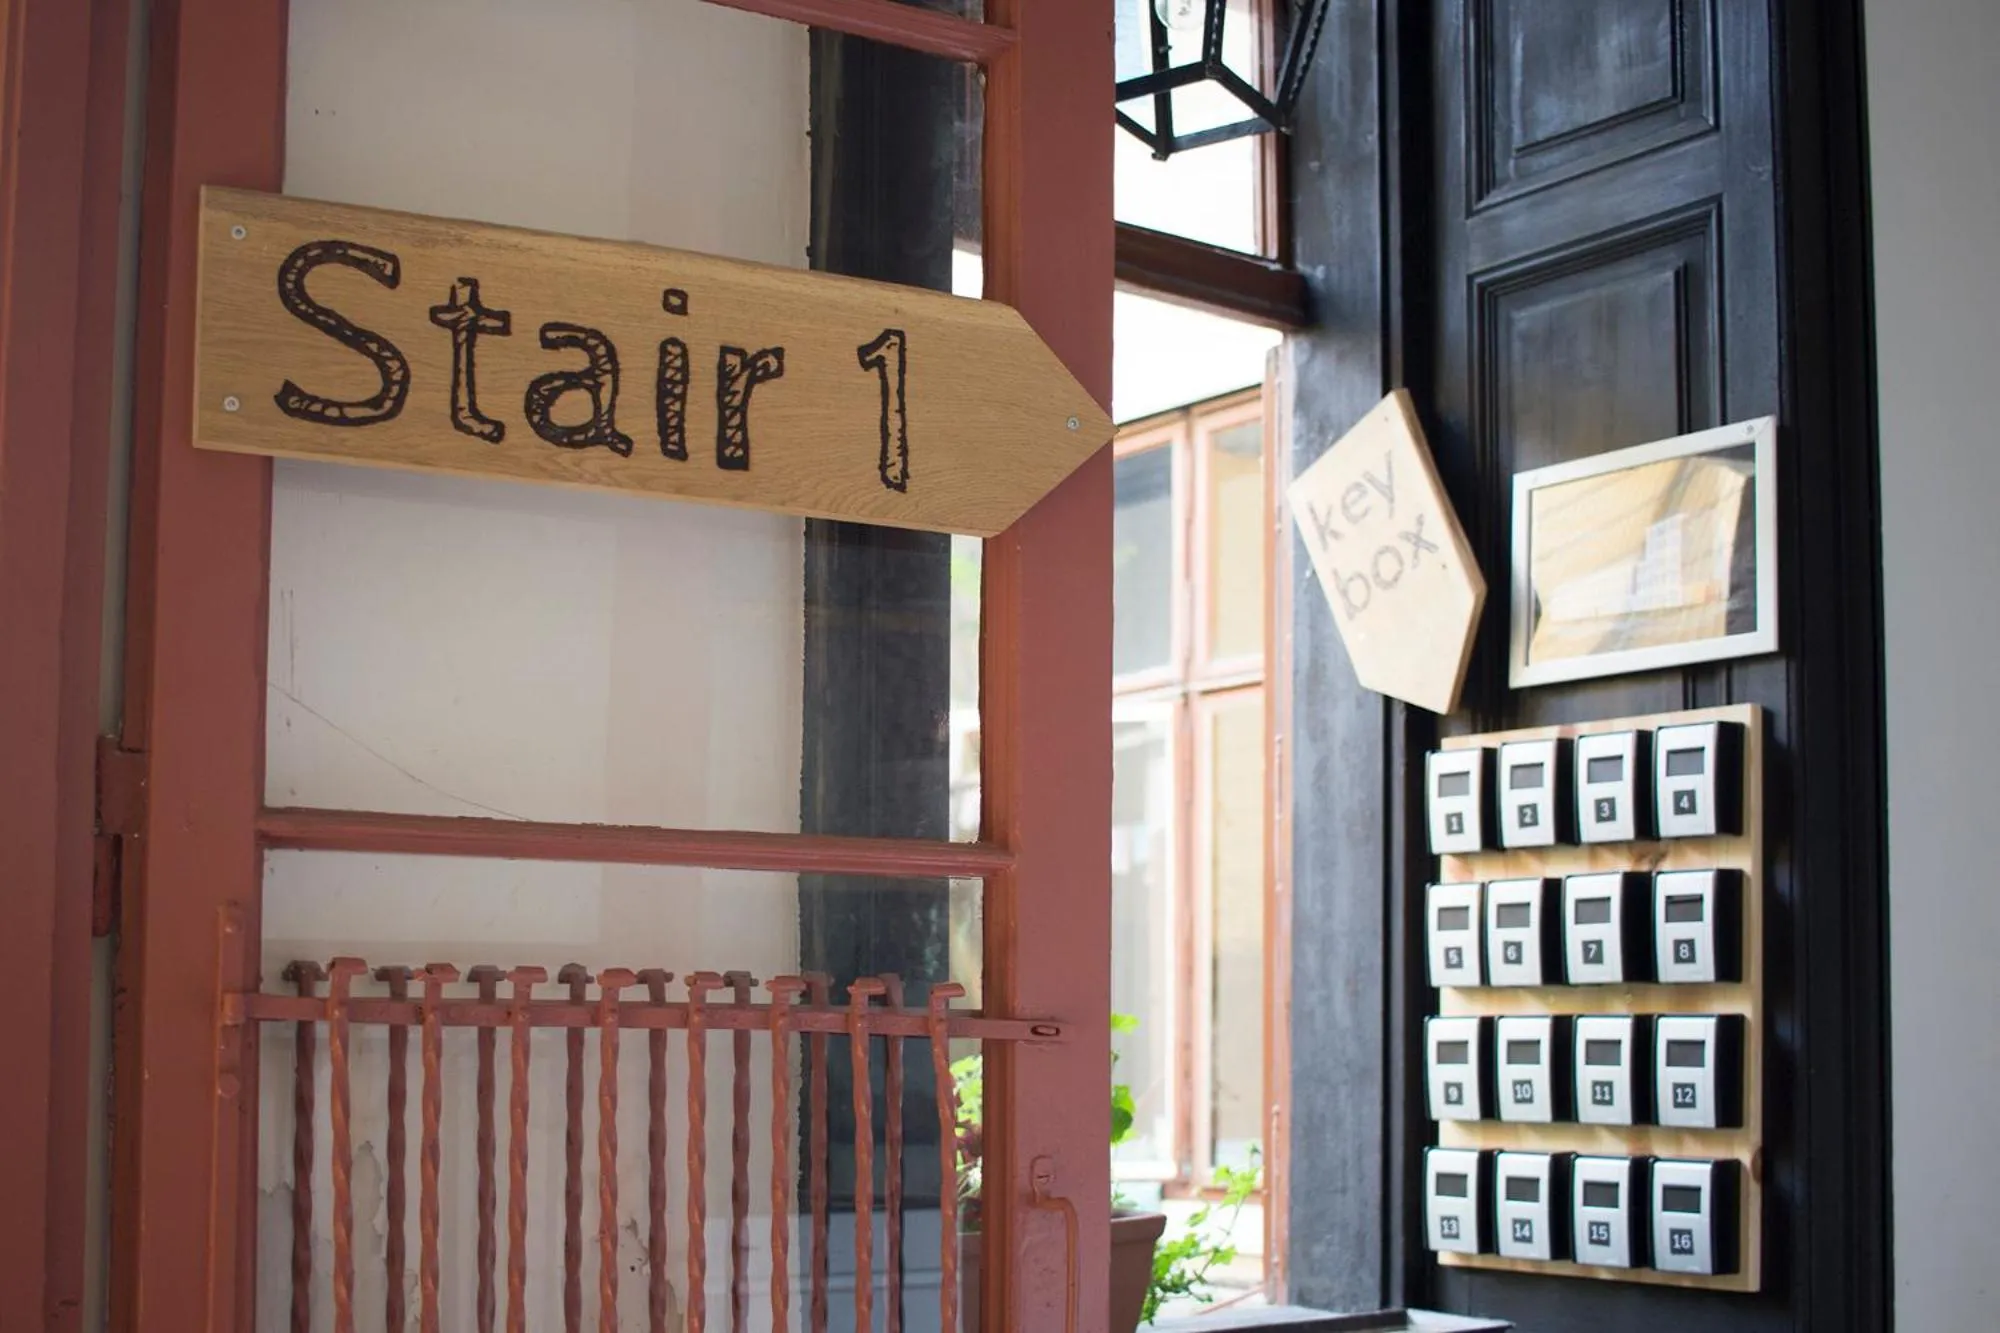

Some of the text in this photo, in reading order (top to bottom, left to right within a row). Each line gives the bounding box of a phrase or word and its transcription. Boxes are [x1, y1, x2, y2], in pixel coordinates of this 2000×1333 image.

[274, 239, 911, 493] Stair 1
[1308, 449, 1395, 553] key
[1332, 513, 1440, 621] box
[1599, 800, 1611, 819] 3
[1678, 793, 1691, 811] 4
[1450, 815, 1460, 832] 1
[1522, 806, 1534, 824] 2
[1447, 948, 1460, 966] 5
[1505, 944, 1518, 962] 6
[1586, 942, 1599, 960] 7
[1678, 942, 1691, 960] 8
[1447, 1085, 1460, 1102] 9
[1514, 1082, 1533, 1100] 10
[1593, 1084, 1612, 1102] 11
[1675, 1086, 1694, 1104] 12
[1441, 1218, 1459, 1236] 13
[1513, 1222, 1531, 1239] 14
[1590, 1224, 1609, 1242] 15
[1672, 1233, 1692, 1250] 16
